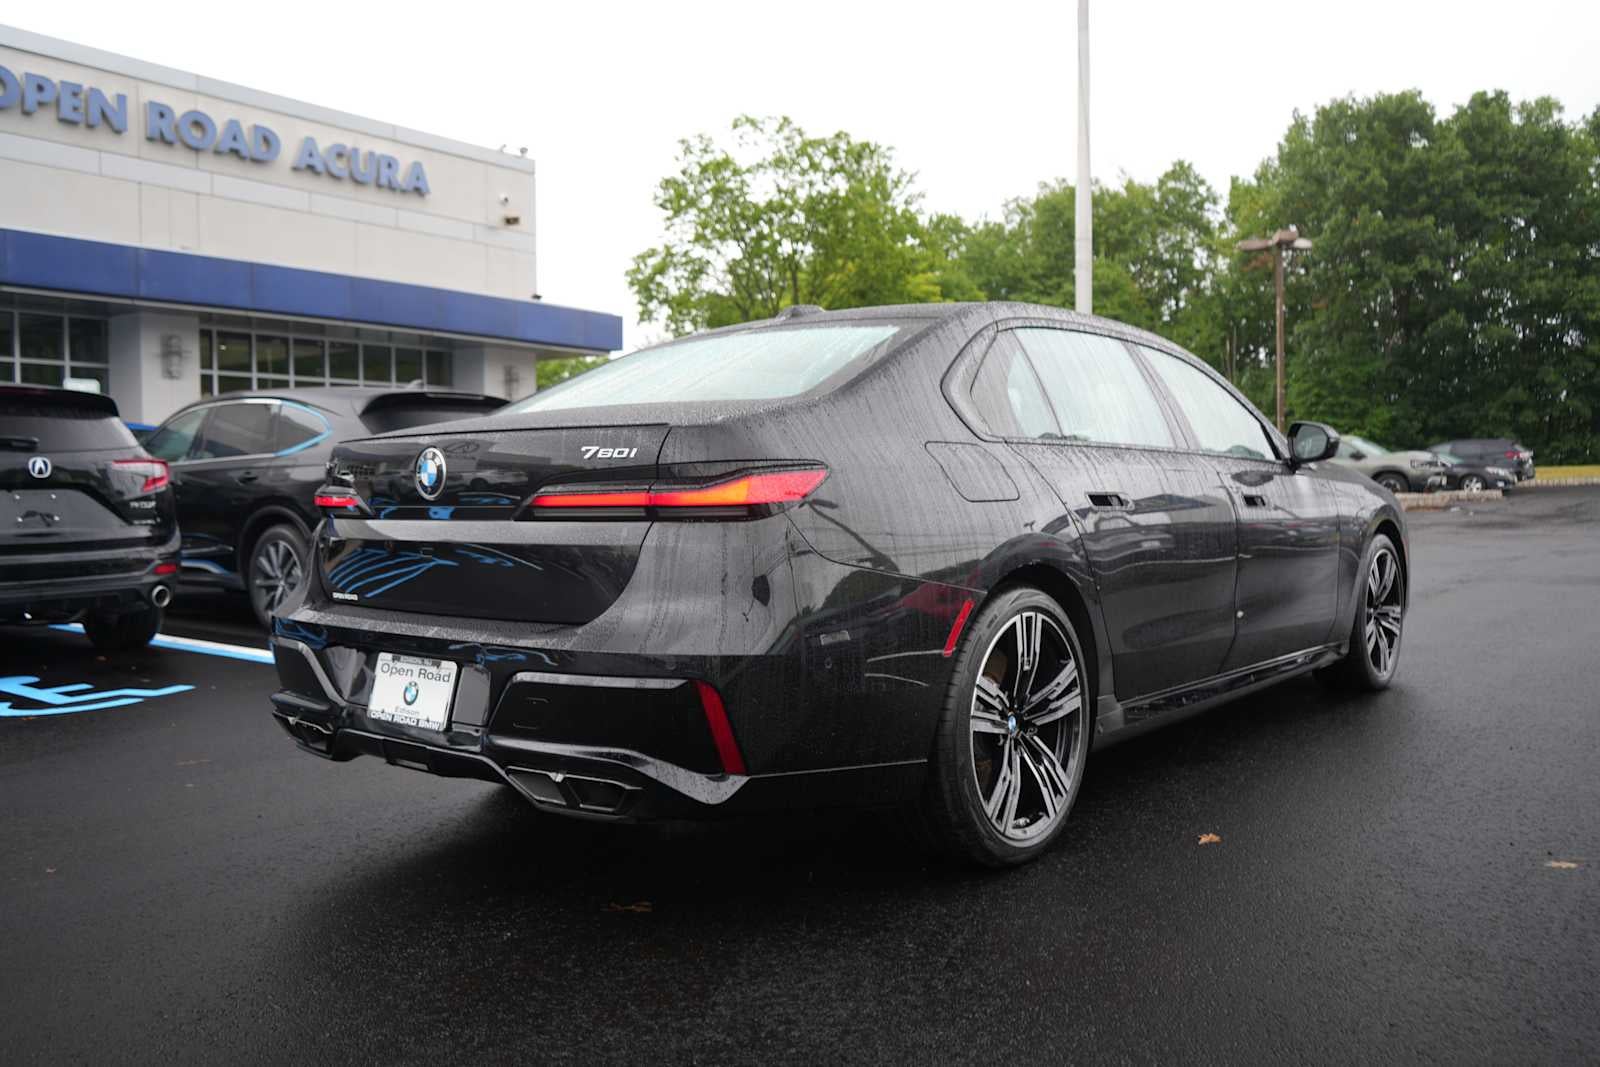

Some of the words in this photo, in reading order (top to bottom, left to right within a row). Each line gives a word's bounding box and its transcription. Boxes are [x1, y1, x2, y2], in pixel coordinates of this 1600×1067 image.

[144, 100, 281, 163] ROAD
[291, 135, 430, 197] ACURA
[380, 662, 413, 677] Open
[418, 668, 451, 682] Road
